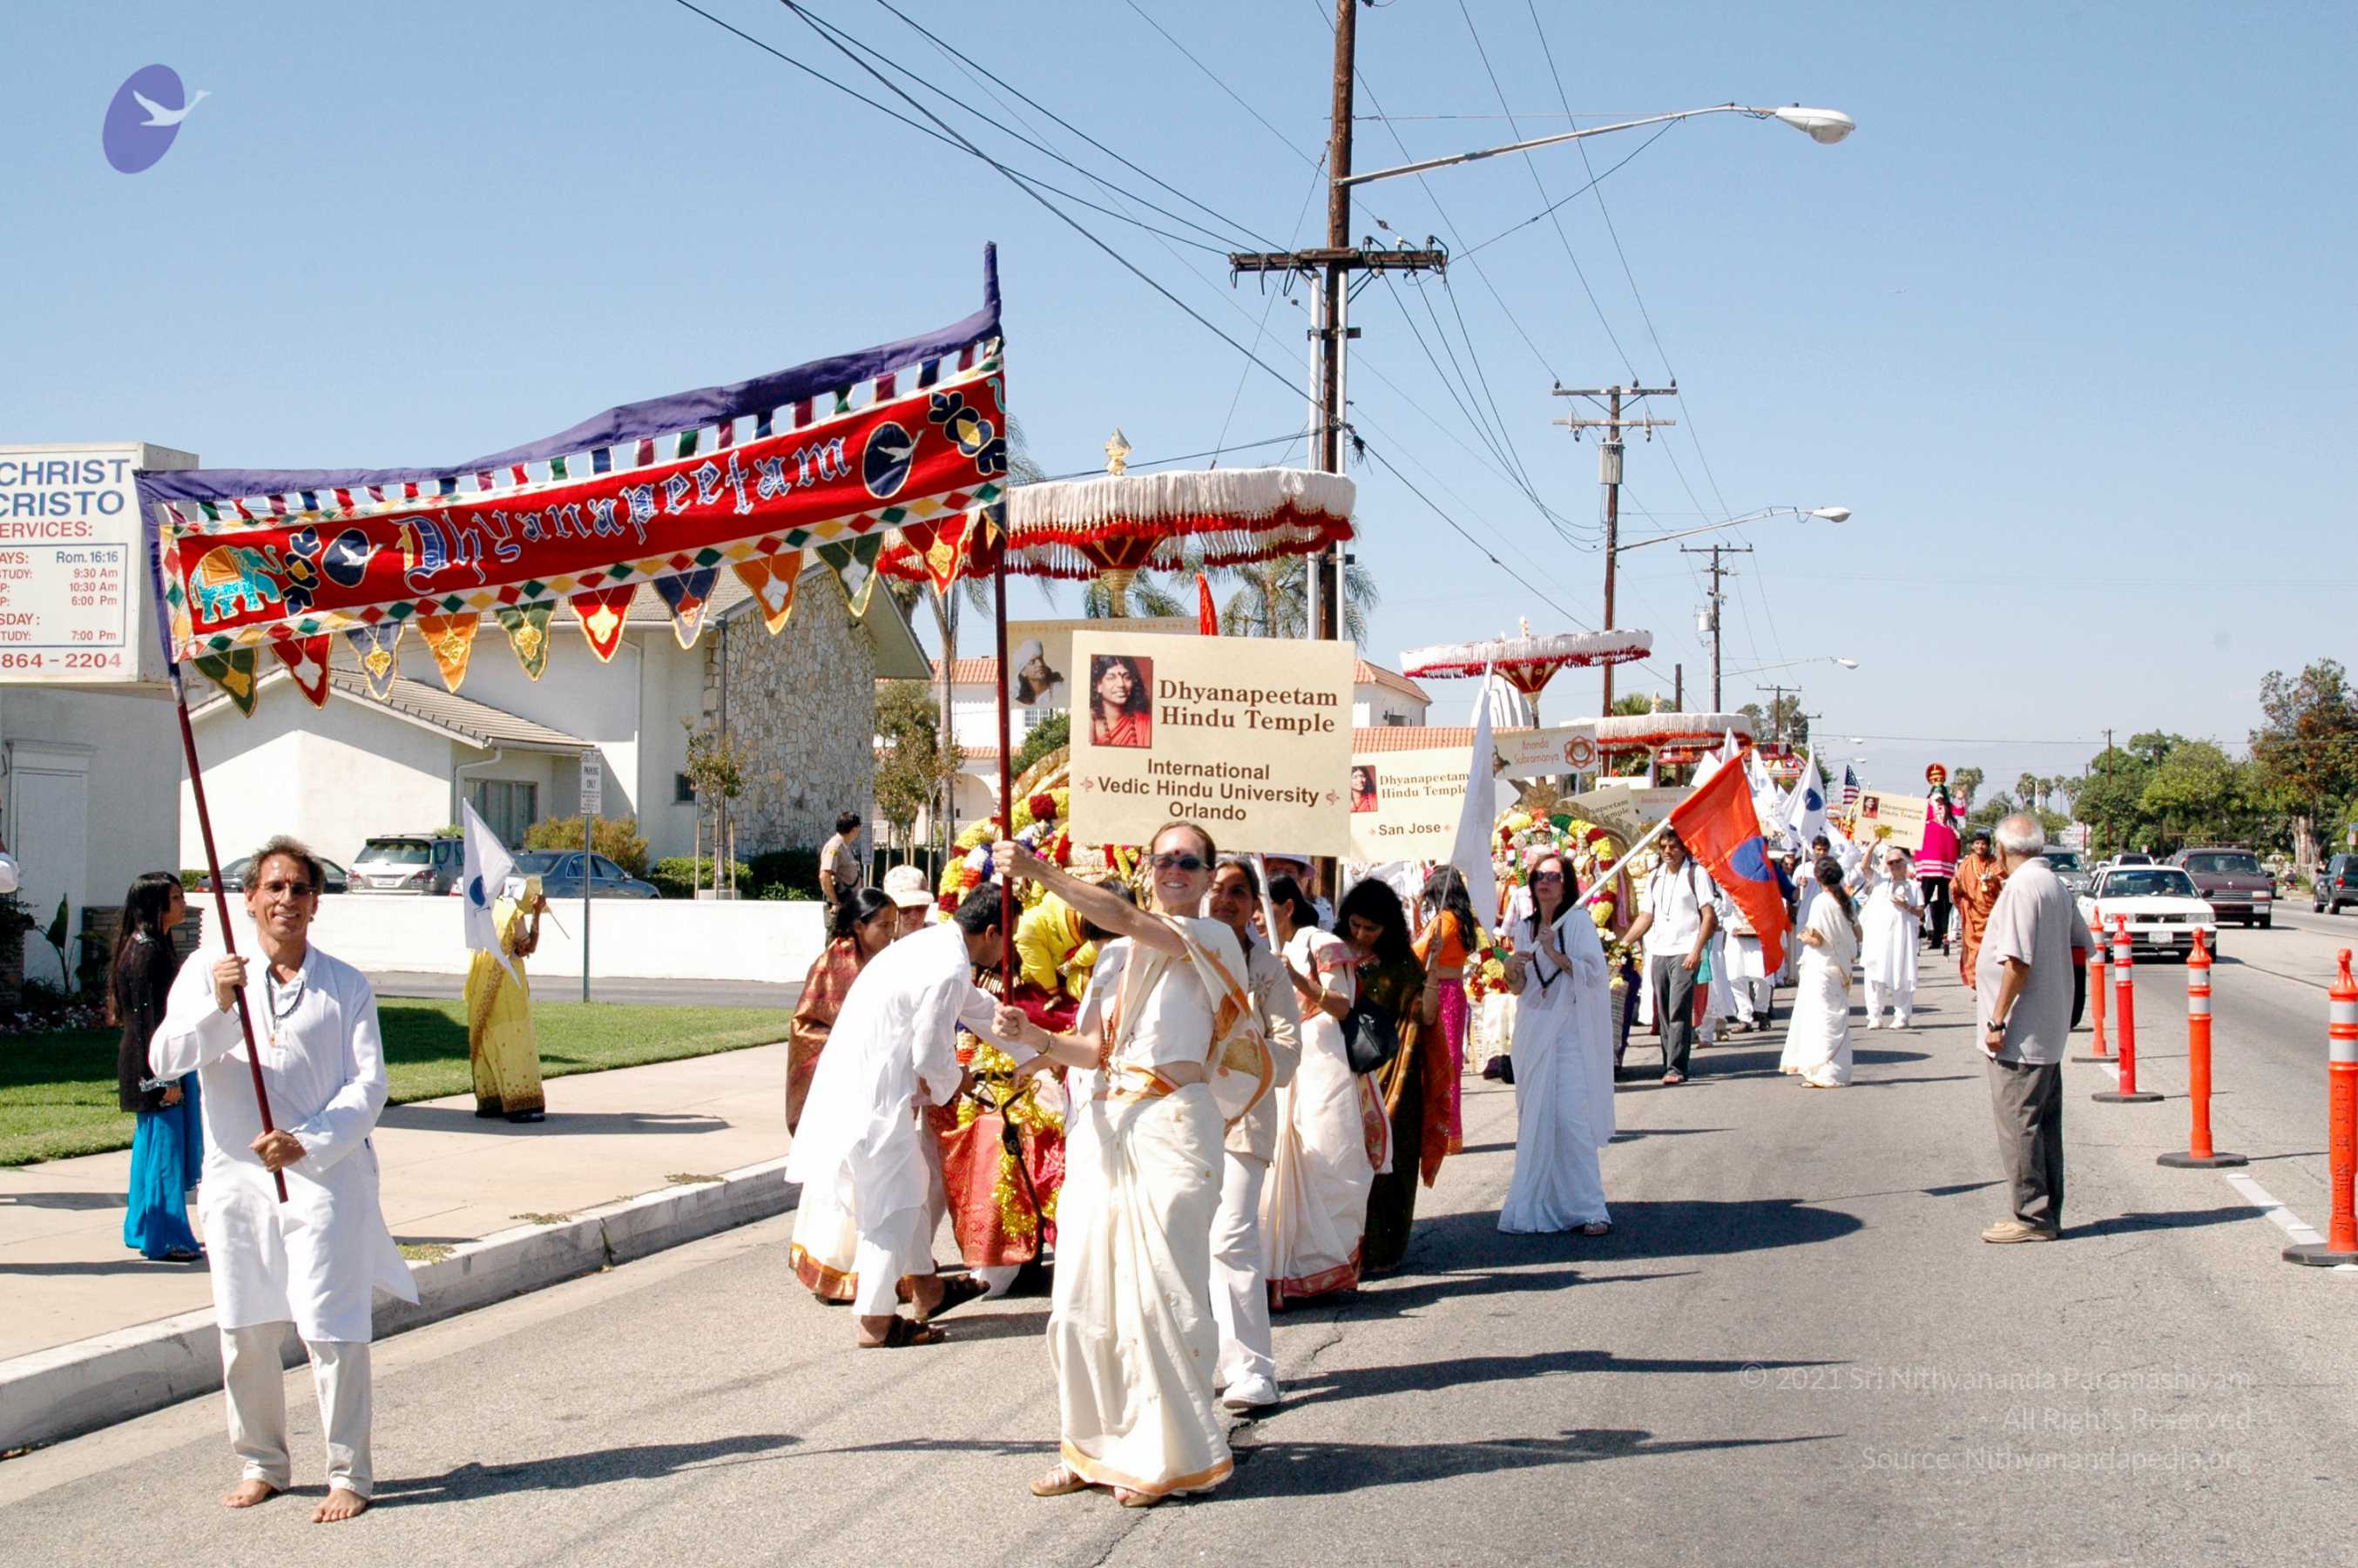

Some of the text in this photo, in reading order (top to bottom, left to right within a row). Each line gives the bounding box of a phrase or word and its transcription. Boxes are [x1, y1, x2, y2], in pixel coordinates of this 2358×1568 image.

[0, 458, 130, 486] CHRIST
[388, 436, 852, 595] Dhyanapeetam
[56, 551, 118, 564] Rom. 16:16
[0, 569, 32, 579] TUDY:
[73, 568, 118, 578] 9:30 Am
[70, 582, 118, 592] 10:30 Am
[71, 595, 118, 606] 6:00 Pm
[71, 630, 117, 641] 7:00 Pm
[1158, 679, 1339, 707] Dhyanapeetam
[1160, 706, 1335, 736] Hindu Temple
[1147, 758, 1270, 781] International
[1098, 777, 1320, 808] Vedic Hindu University
[1382, 787, 1419, 799] Hindu
[1168, 801, 1247, 821] Orlando
[1379, 822, 1441, 836] San Jose
